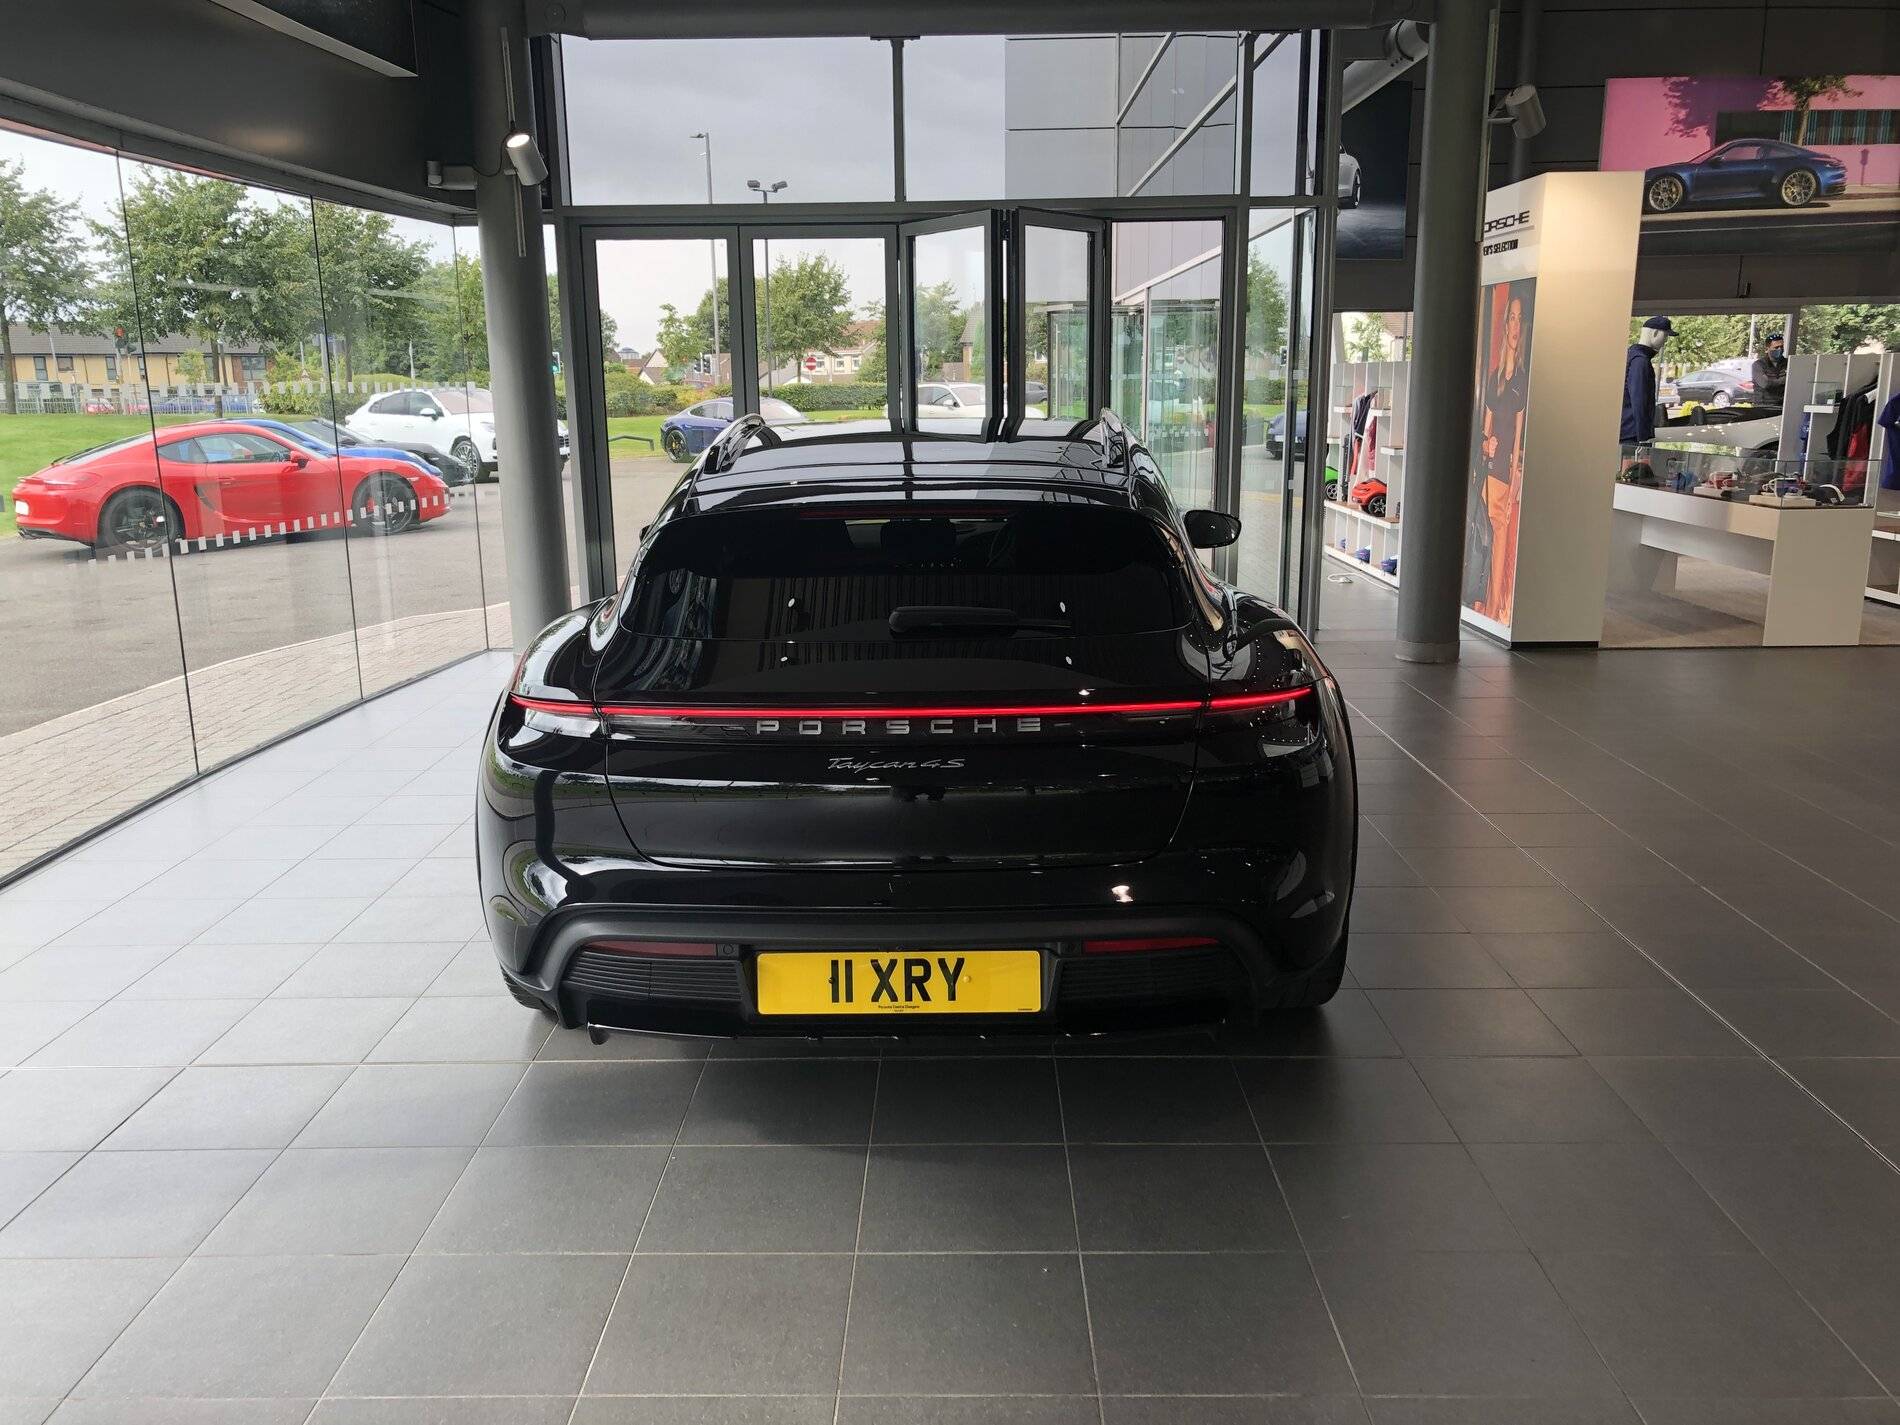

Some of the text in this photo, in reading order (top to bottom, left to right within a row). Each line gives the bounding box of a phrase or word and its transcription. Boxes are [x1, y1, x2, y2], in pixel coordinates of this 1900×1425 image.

[1484, 210, 1530, 233] ORSCHE
[1494, 239, 1518, 253] SELECTION
[756, 717, 1041, 735] PORSCHE
[827, 757, 966, 774] Taycan 4S
[870, 957, 965, 1003] XRY
